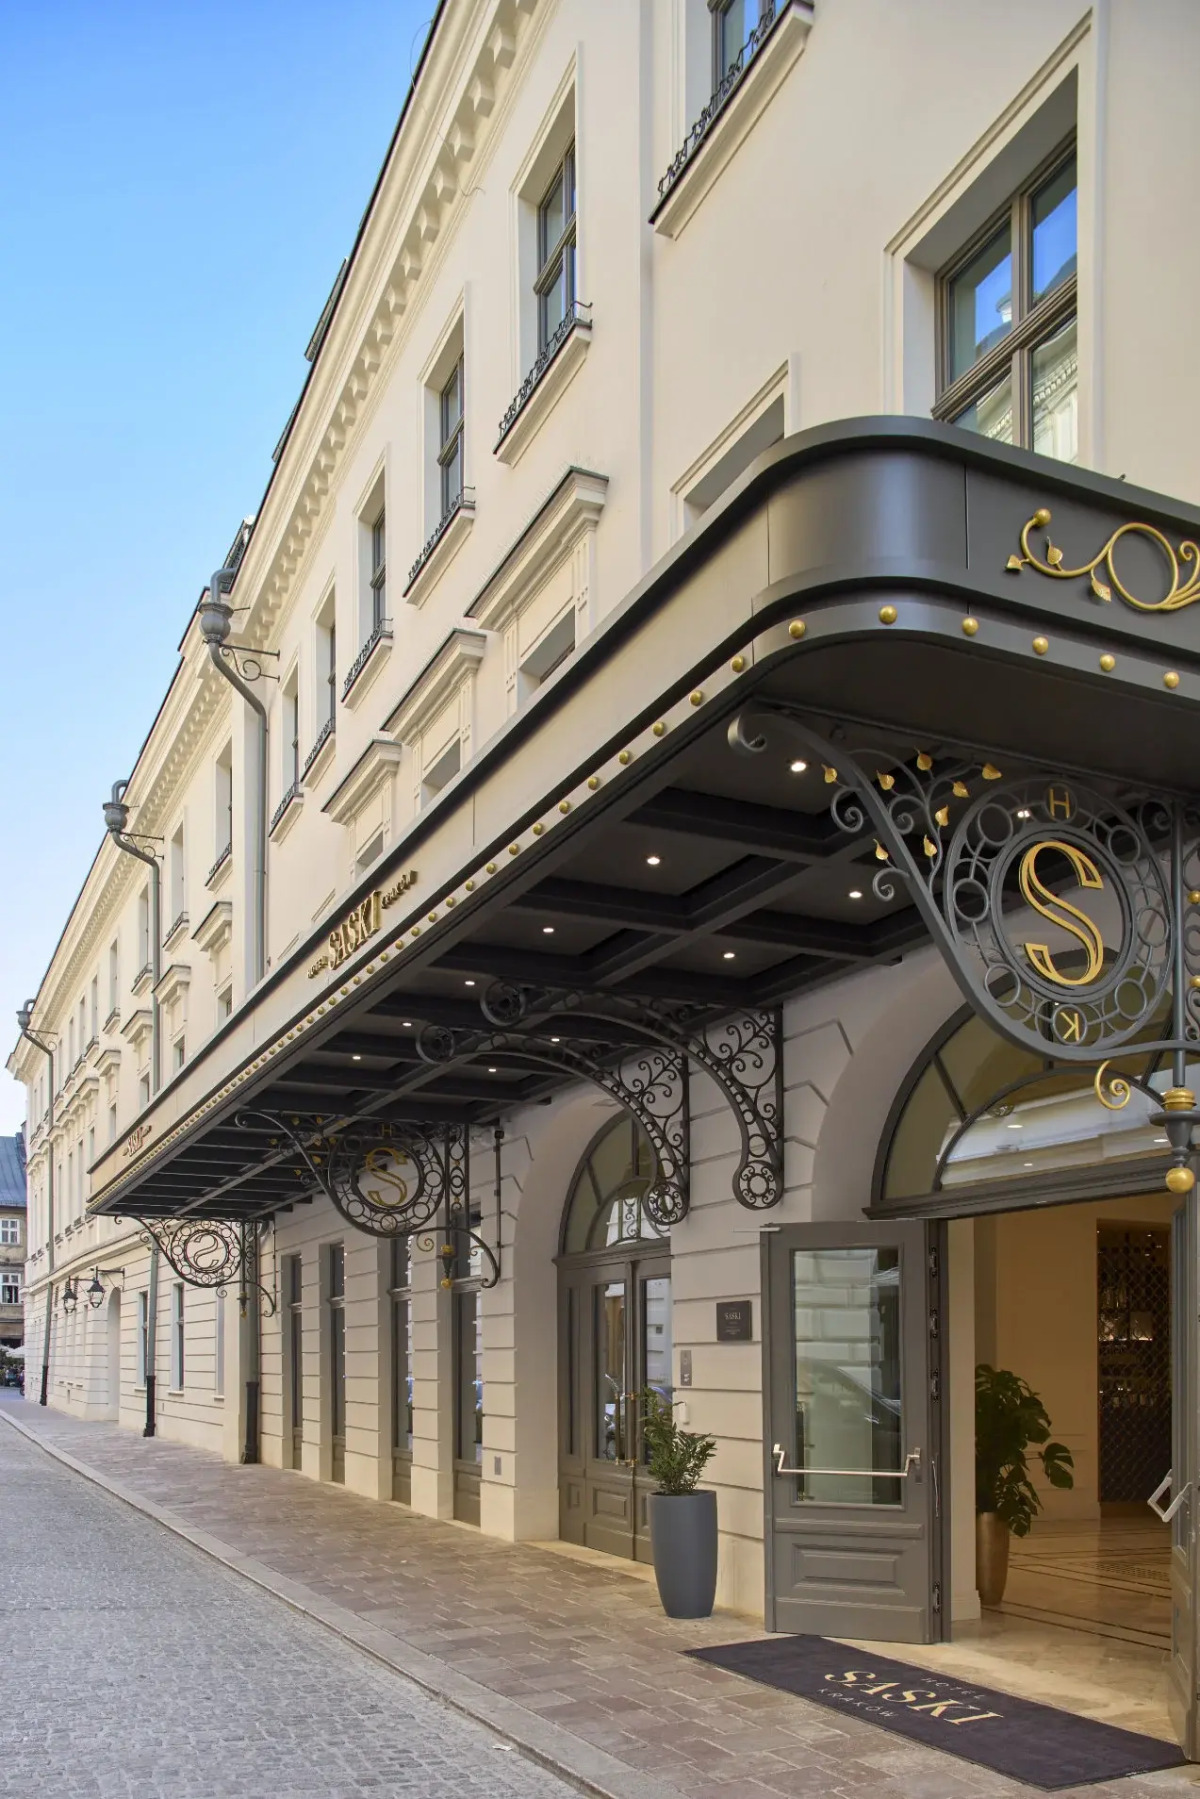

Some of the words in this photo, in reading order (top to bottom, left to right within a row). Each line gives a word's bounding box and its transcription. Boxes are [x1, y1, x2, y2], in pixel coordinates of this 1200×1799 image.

[1049, 788, 1071, 820] H
[328, 890, 382, 970] SASKI
[1018, 840, 1104, 986] S
[365, 1146, 408, 1208] S
[824, 1670, 1004, 1725] SASKI
